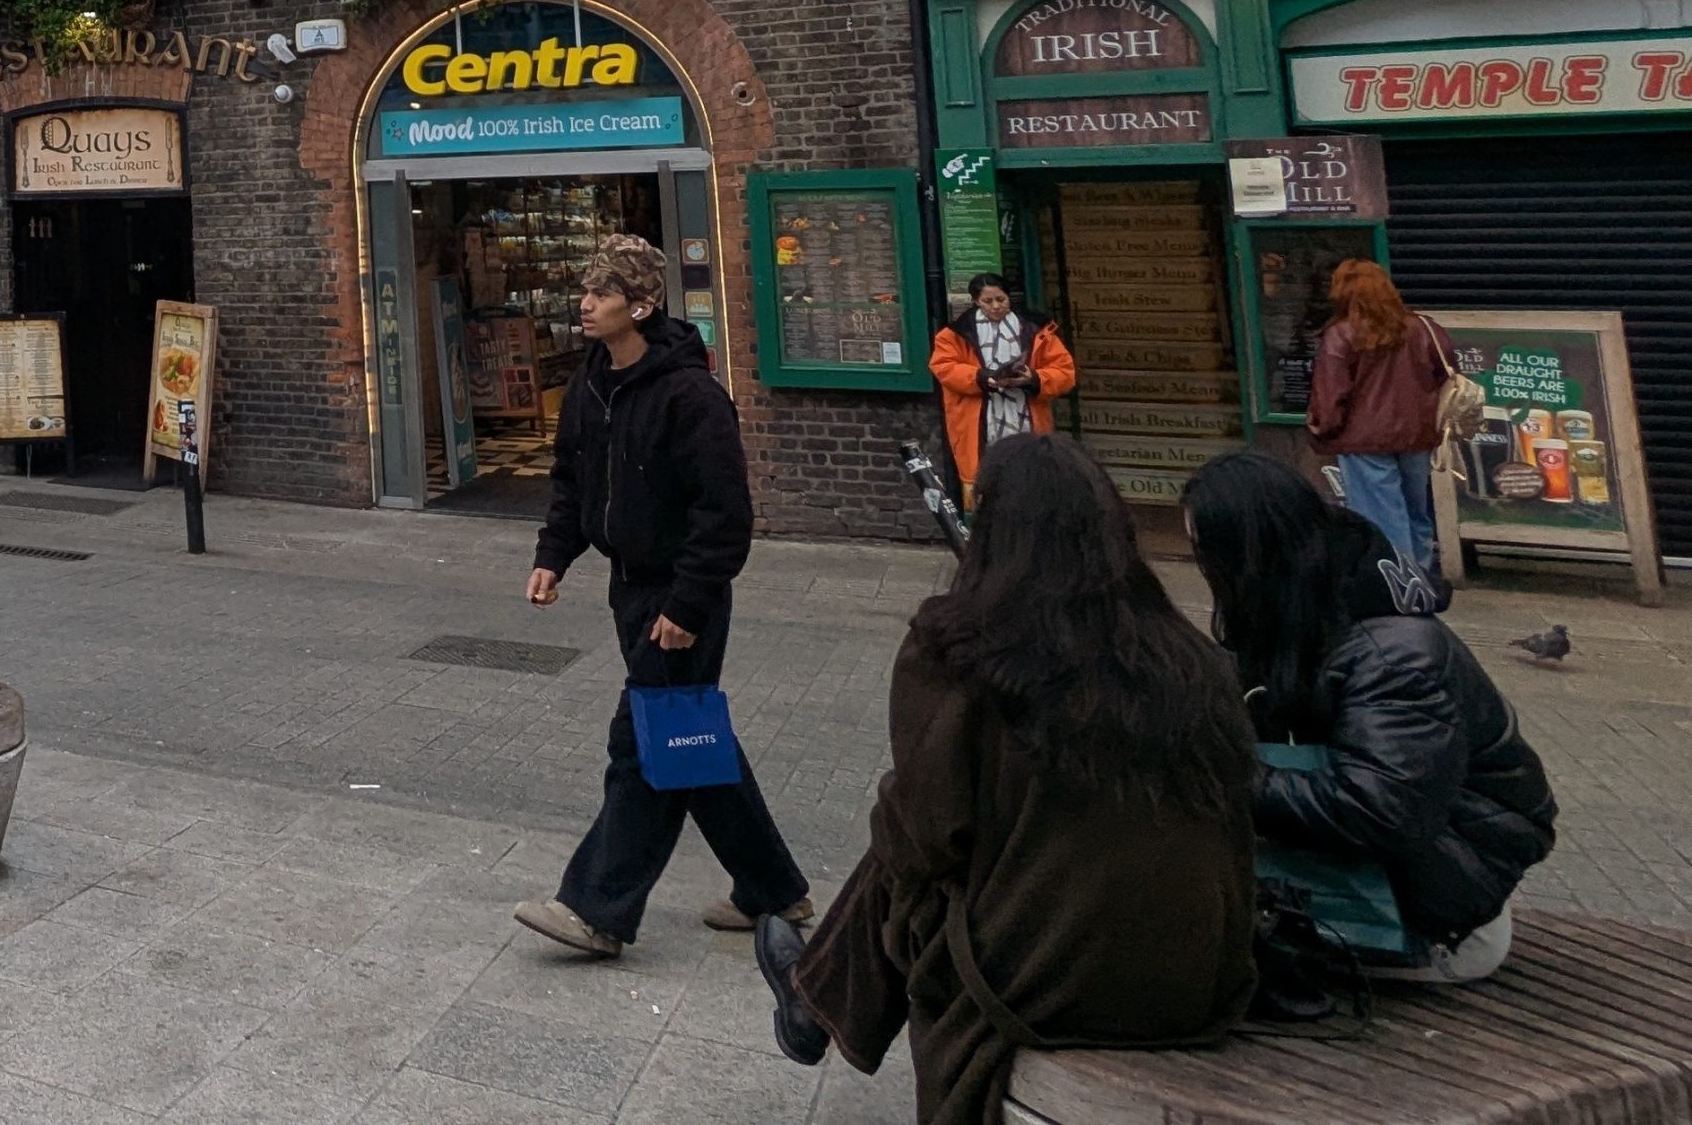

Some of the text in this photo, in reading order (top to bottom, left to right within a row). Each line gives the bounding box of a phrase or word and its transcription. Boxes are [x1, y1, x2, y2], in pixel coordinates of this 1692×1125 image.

[1031, 29, 1164, 63] IRISH
[402, 37, 639, 97] Centra
[1341, 55, 1608, 112] TEMPLE
[409, 112, 661, 146] Mood 100% Irish Ice Cream
[1007, 110, 1201, 134] RESTAURANT
[41, 116, 151, 159] Quays
[381, 283, 398, 334] ATM
[479, 338, 507, 356] TASTY
[481, 354, 515, 373] TREATS
[1125, 350, 1138, 363] &
[1500, 352, 1559, 368] ALL OUR
[1496, 363, 1562, 380] DRAUGHT
[1493, 375, 1565, 393] BEERS ARE
[1493, 386, 1566, 404] 100% IRISH
[1081, 410, 1224, 430] ull Irish Breakfast
[1168, 447, 1207, 462] Men
[1130, 478, 1163, 495] Old
[667, 734, 717, 748] ARNOTTS
